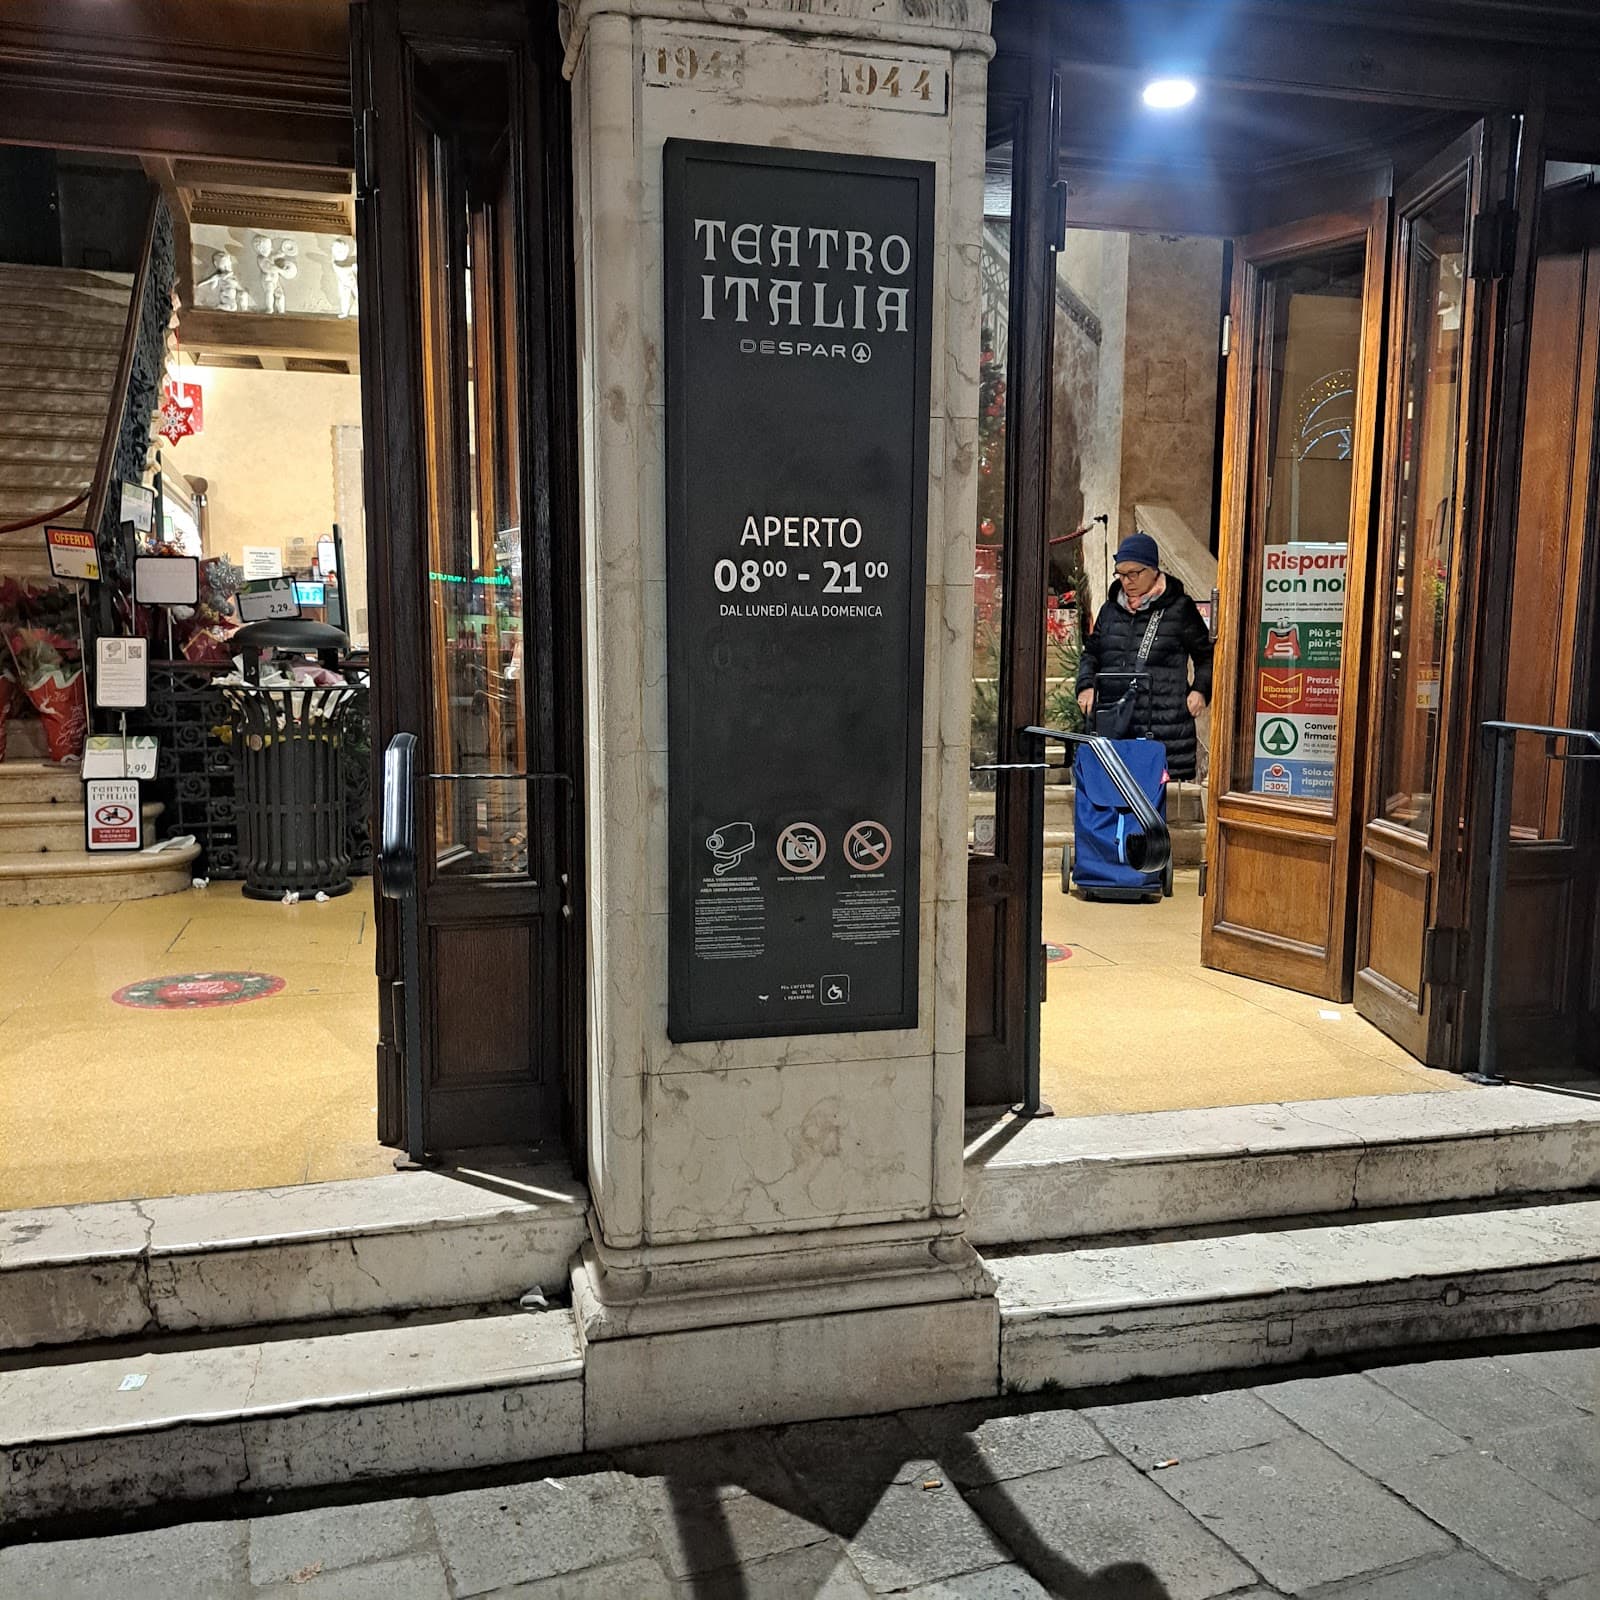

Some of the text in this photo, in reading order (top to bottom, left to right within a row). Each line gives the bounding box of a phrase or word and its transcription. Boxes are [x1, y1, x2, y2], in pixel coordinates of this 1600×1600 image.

[840, 62, 932, 101] 1944
[694, 218, 911, 276] TEATRO
[700, 274, 910, 333] ITALIA
[740, 338, 846, 358] DESPAR
[739, 515, 862, 548] APERTO
[54, 532, 92, 547] OFFERTA
[1265, 578, 1307, 592] con
[270, 603, 288, 614] 2,29
[719, 602, 883, 617] DAL LUNEDÌ ALLA DOMENICA
[1309, 628, 1323, 638] Più
[1308, 639, 1323, 649] più
[1306, 675, 1333, 685] Prezzi
[1302, 767, 1321, 776] Solo
[1265, 783, 1288, 791] -30%
